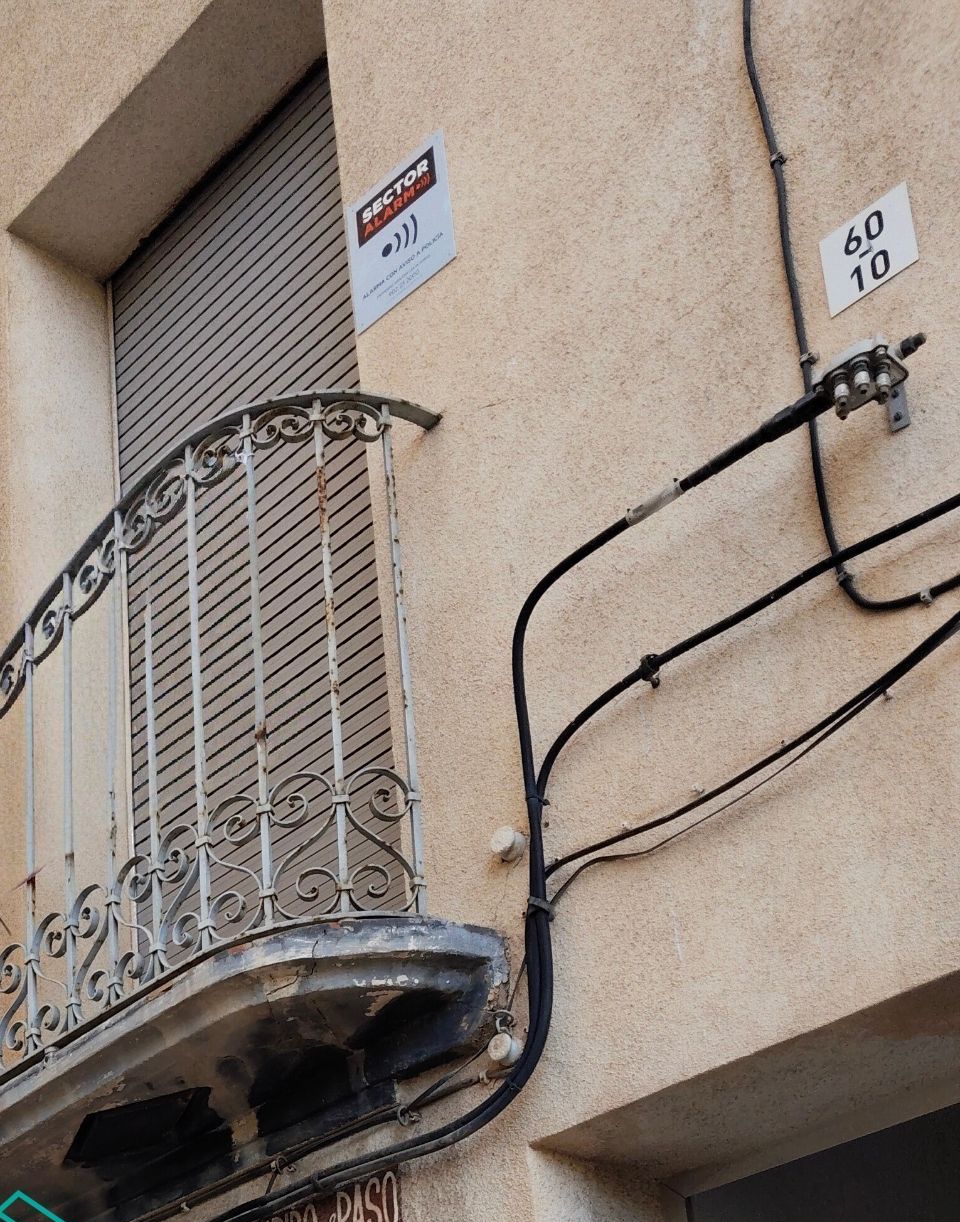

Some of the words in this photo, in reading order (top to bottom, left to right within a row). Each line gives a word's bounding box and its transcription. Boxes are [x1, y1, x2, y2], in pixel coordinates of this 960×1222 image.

[362, 158, 430, 224] SECTOR
[364, 186, 416, 238] ALARM
[844, 209, 884, 256] 60
[385, 267, 398, 280] CON
[850, 249, 890, 293] 10
